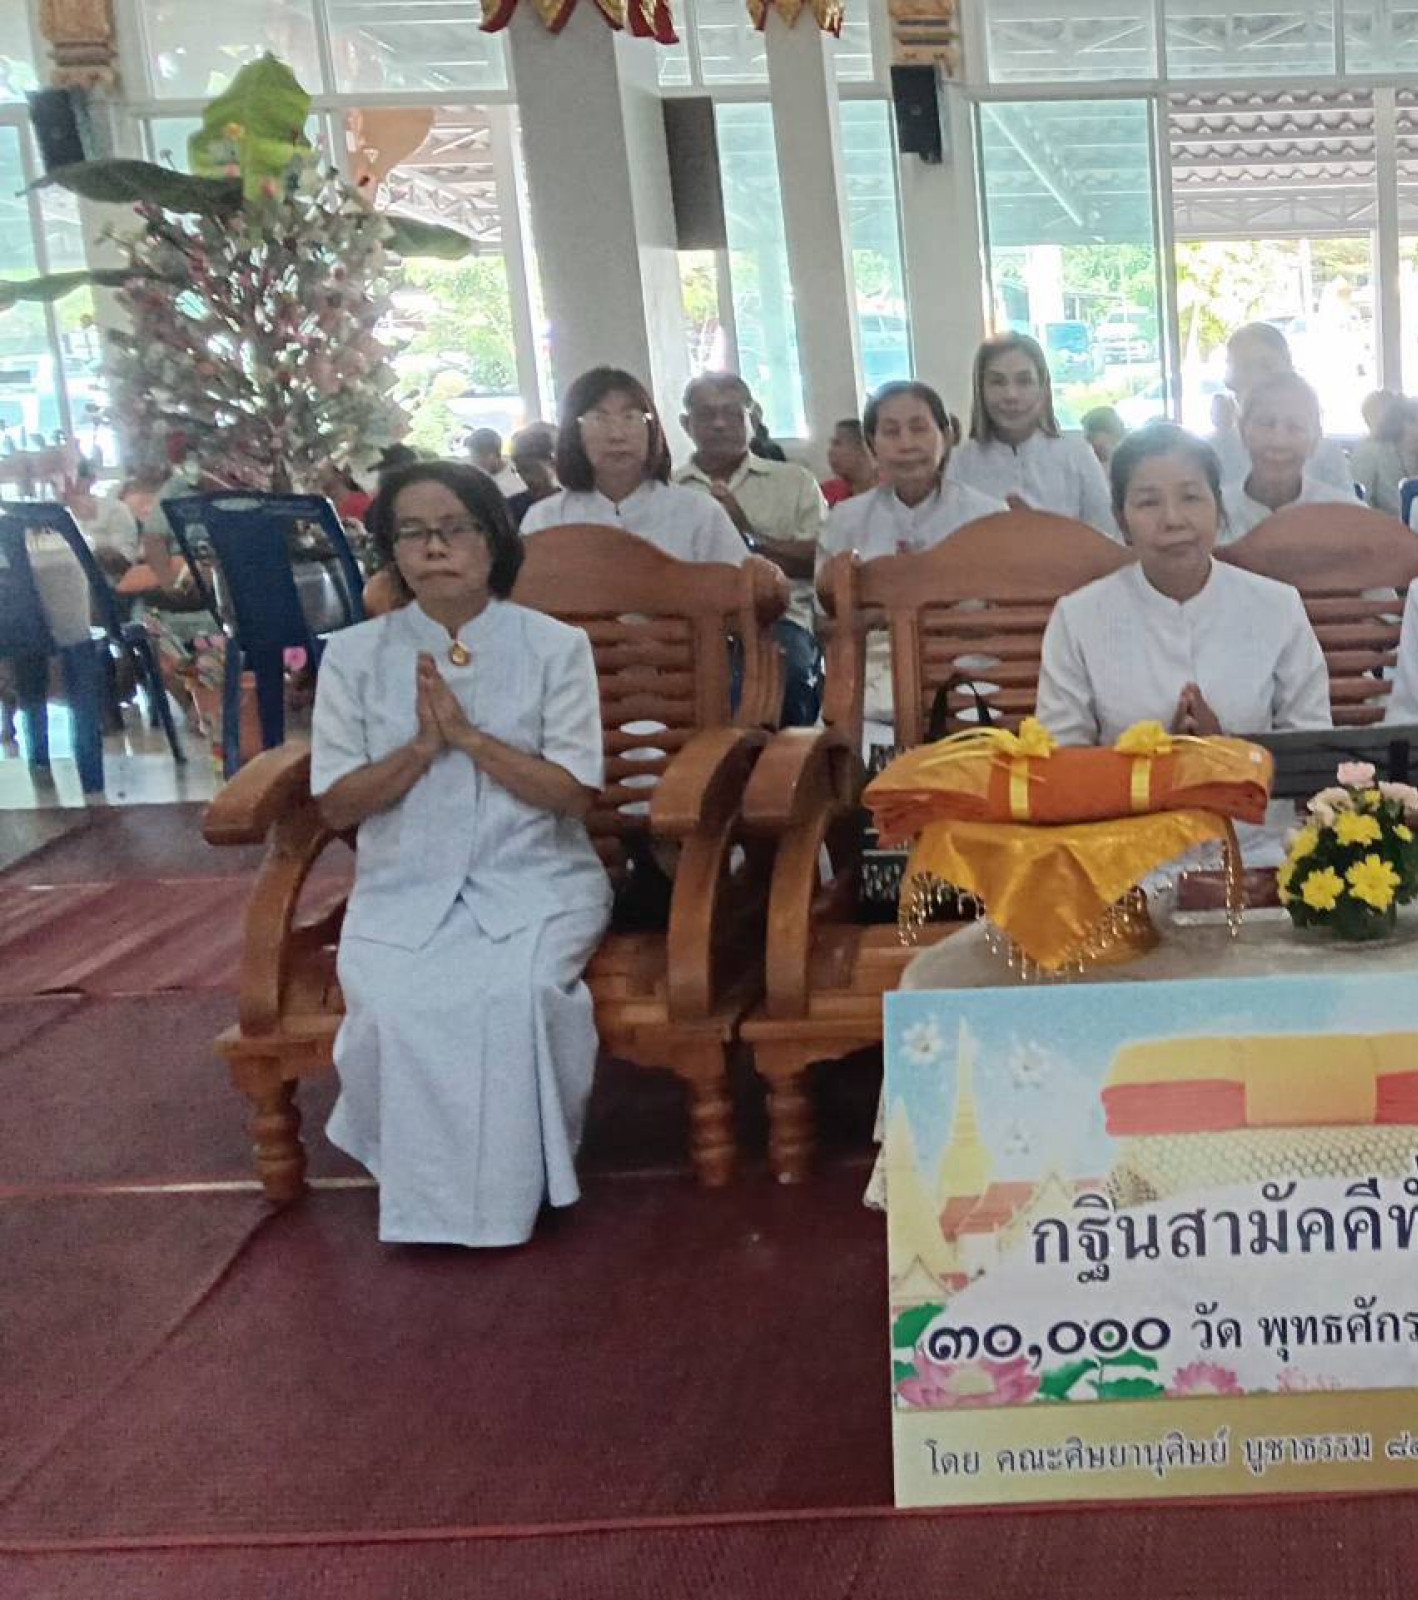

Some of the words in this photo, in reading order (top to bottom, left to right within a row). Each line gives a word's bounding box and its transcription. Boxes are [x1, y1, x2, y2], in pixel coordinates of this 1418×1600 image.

[928, 1316, 1171, 1370] ๓๐,๐๐๐
[1191, 1301, 1243, 1350] วัด
[924, 1439, 980, 1476] โดย
[996, 1426, 1230, 1478] คณะศิษยานุศิษย์
[1244, 1432, 1372, 1475] บูชาธรรม
